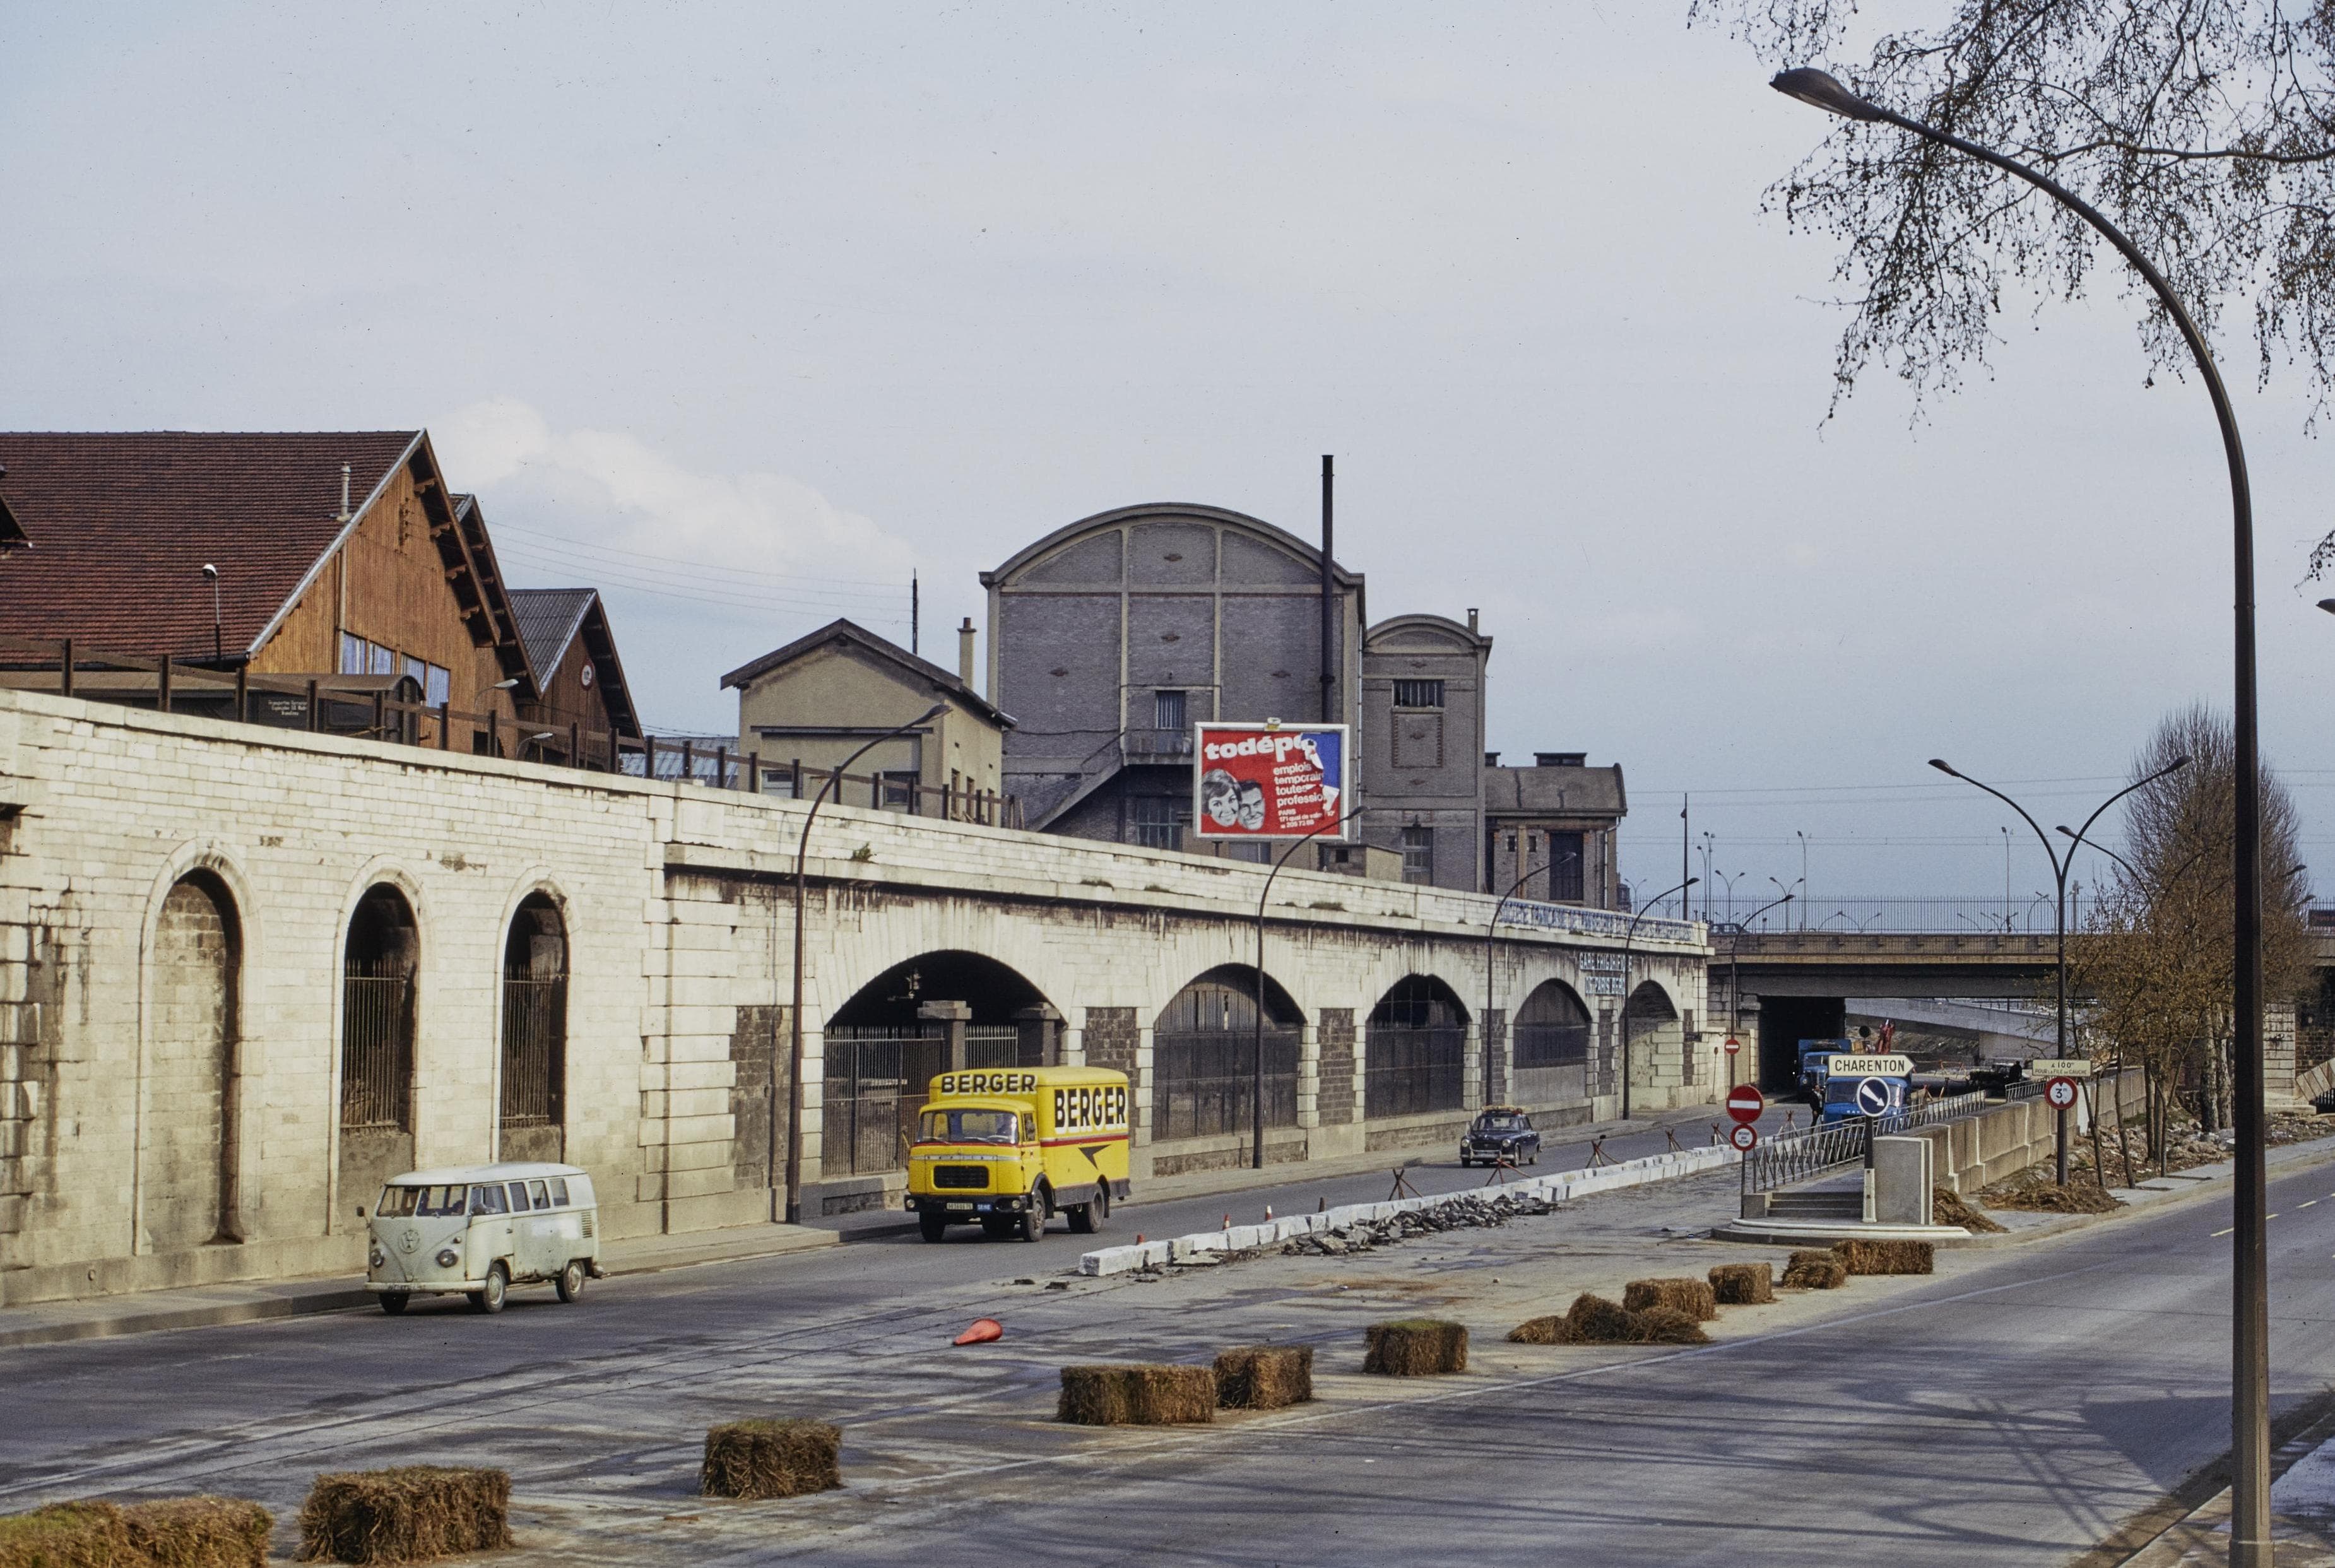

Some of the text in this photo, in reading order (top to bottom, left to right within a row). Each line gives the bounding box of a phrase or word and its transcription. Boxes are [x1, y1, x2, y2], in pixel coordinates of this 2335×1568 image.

[1273, 762, 1312, 775] emplois
[1275, 784, 1308, 795] toutes
[1835, 1059, 1905, 1072] CHARENTON
[941, 1073, 1036, 1093] BERGER
[1054, 1087, 1126, 1129] BERGER
